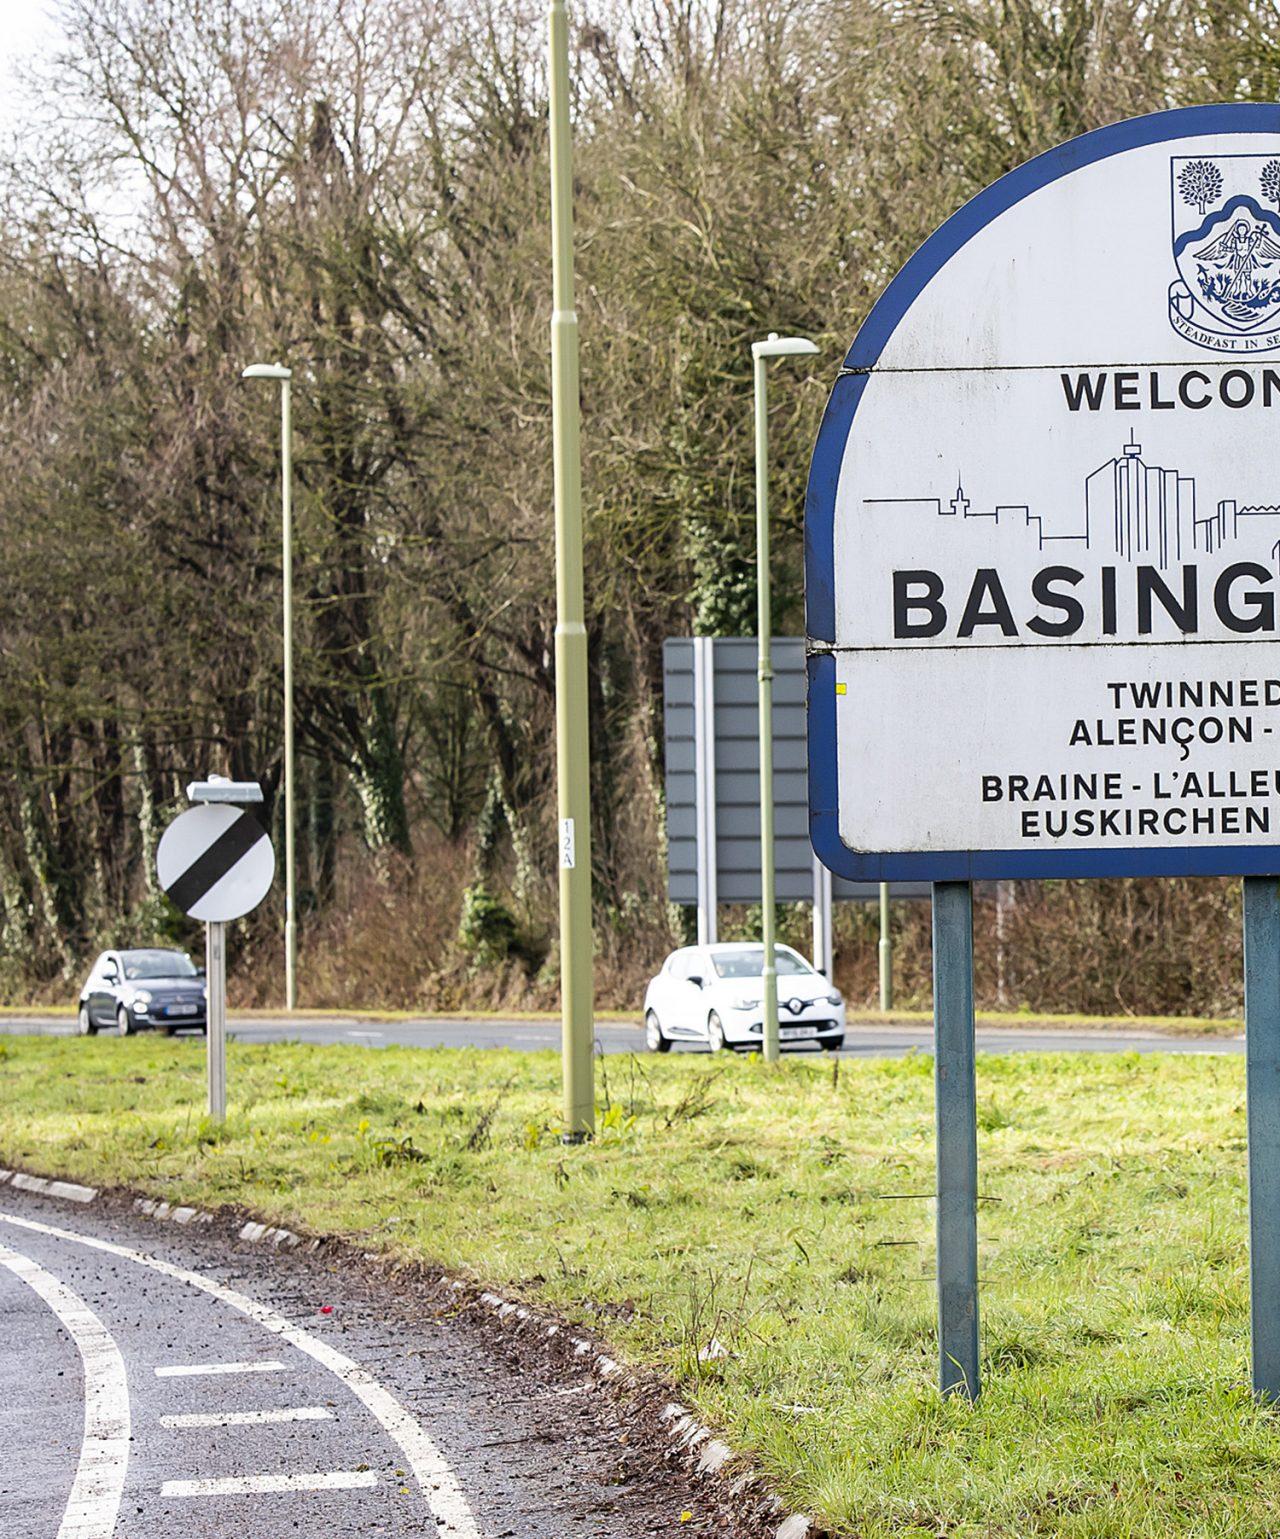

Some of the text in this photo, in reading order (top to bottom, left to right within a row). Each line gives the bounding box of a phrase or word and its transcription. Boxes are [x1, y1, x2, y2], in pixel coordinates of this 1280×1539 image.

[1172, 315, 1237, 350] STEADFAST
[1244, 338, 1258, 349] IN
[1069, 714, 1253, 761] ALENÇON
[981, 773, 1123, 802] BRAINE
[1021, 806, 1270, 839] EUSKIRCHEN
[563, 820, 573, 867] 12A
